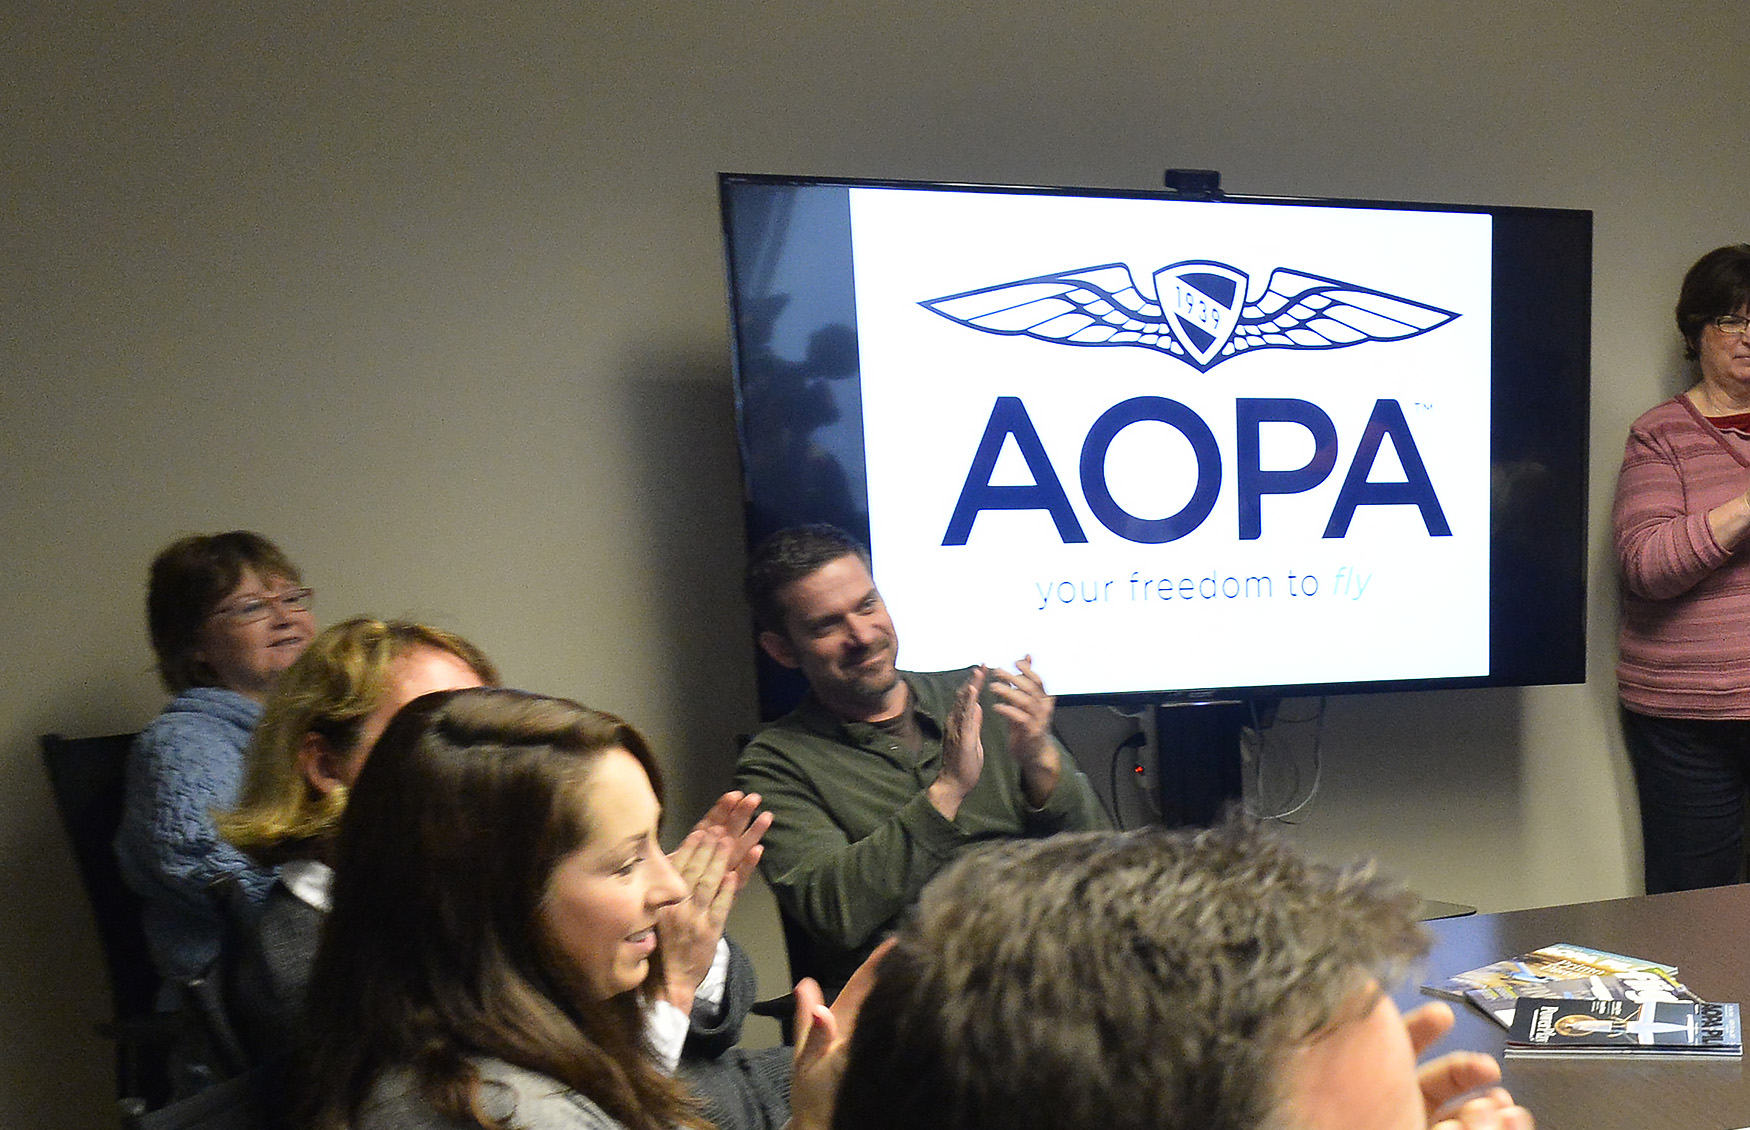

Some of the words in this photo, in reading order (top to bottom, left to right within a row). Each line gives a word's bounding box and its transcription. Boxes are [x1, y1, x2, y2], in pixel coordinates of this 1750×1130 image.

[1175, 286, 1221, 330] 1939
[941, 395, 1453, 546] AOPA
[1035, 578, 1114, 610] your
[1130, 570, 1273, 601] freedom
[1288, 569, 1319, 597] to
[1332, 566, 1373, 601] fly
